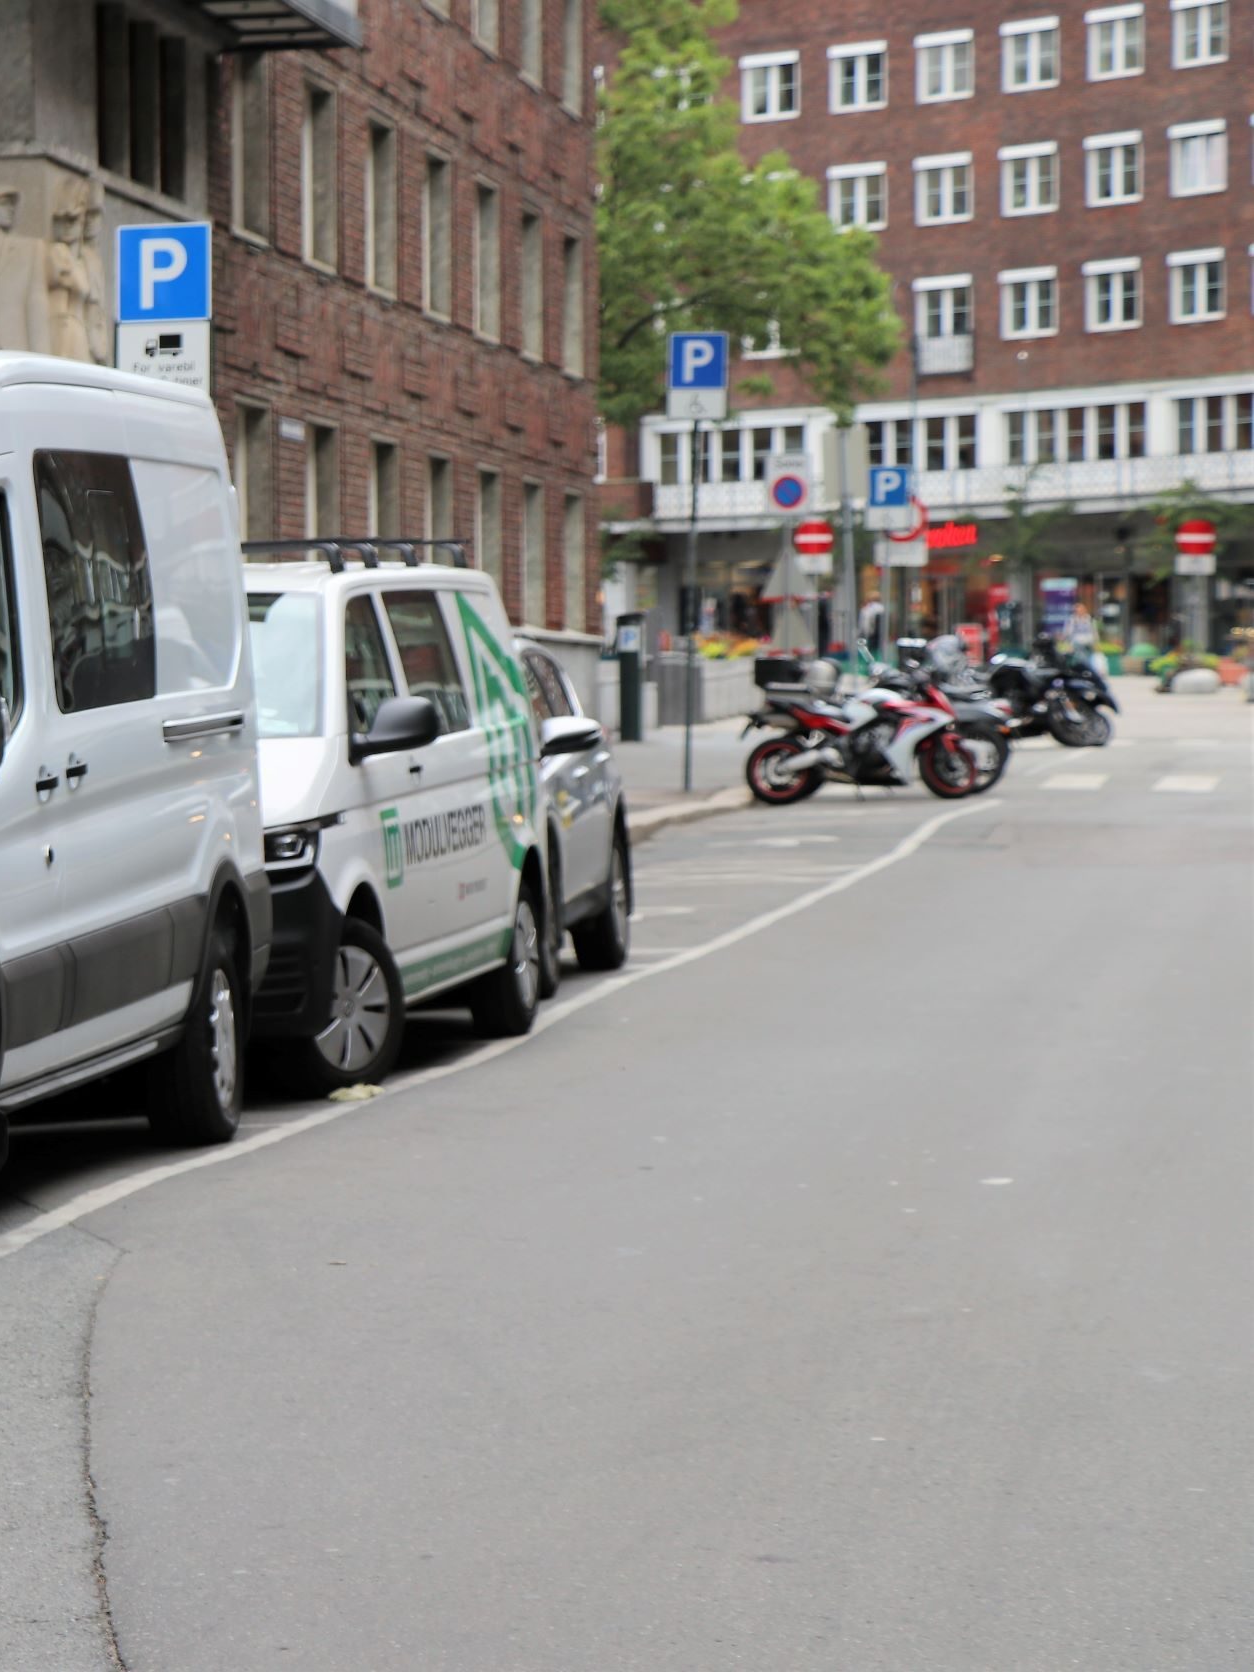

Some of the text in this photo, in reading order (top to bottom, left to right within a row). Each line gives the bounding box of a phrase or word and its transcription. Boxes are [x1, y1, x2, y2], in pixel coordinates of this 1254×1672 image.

[139, 237, 188, 310] P
[682, 339, 714, 383] P
[874, 471, 901, 503] P
[623, 629, 636, 645] P
[403, 804, 487, 865] MODULVEGGER
